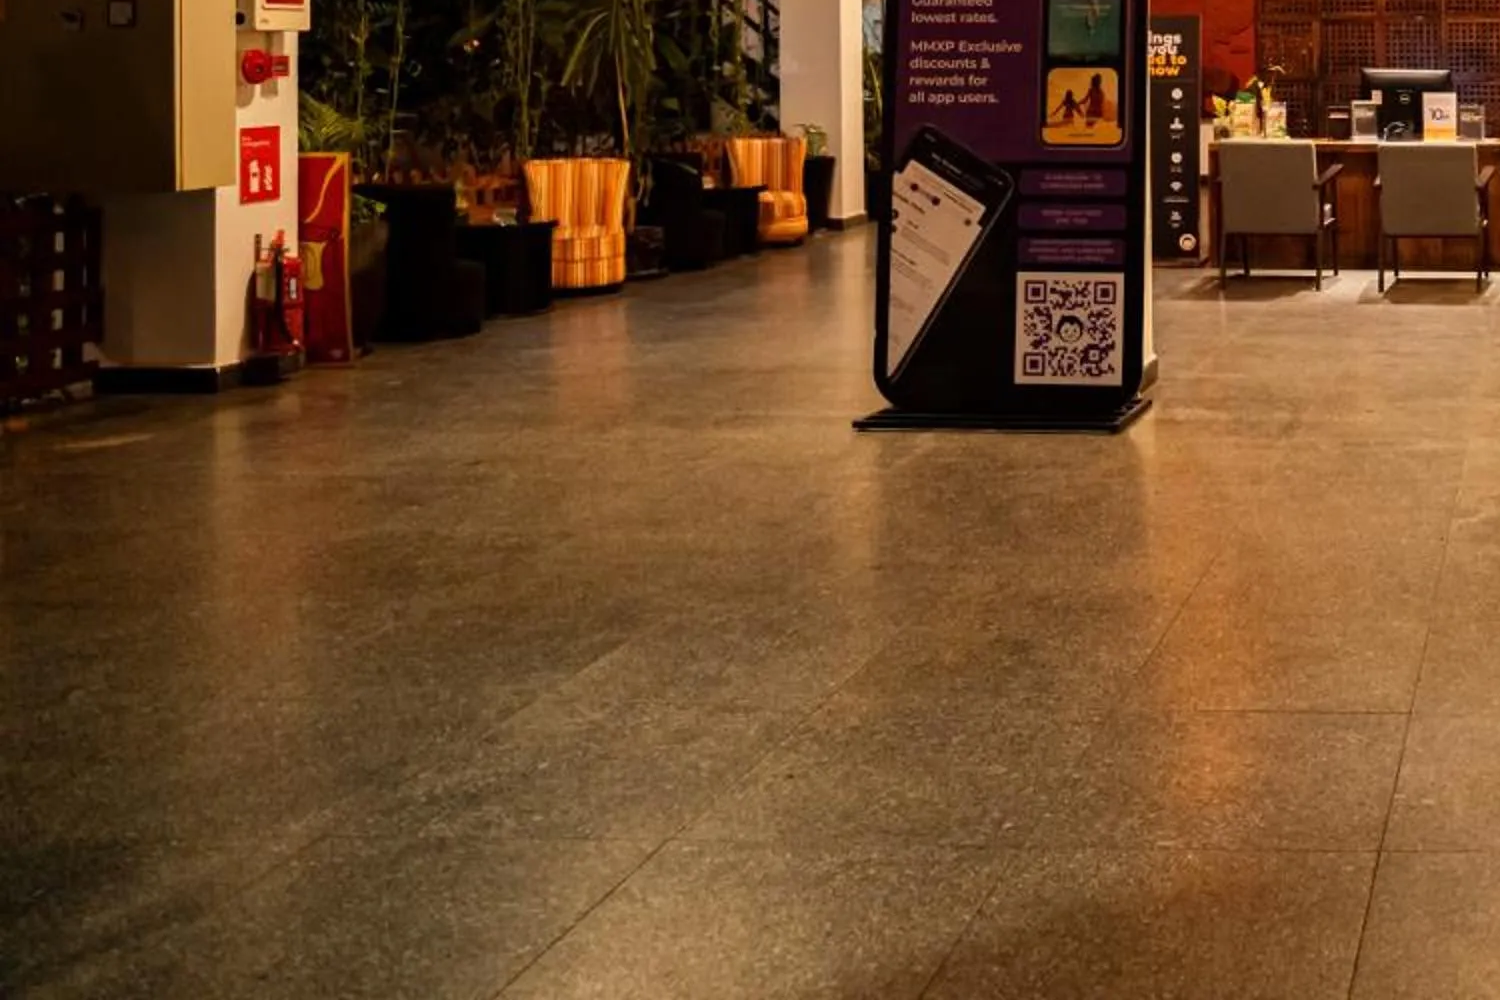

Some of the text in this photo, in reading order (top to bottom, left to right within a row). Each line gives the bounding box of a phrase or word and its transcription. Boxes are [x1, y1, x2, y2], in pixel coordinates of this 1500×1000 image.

[911, 11, 998, 23] lowest rates.
[911, 40, 1022, 53] MMXP Exclusive
[909, 57, 977, 69] discounts
[909, 74, 988, 86] rewards for
[909, 91, 999, 105] all app users.
